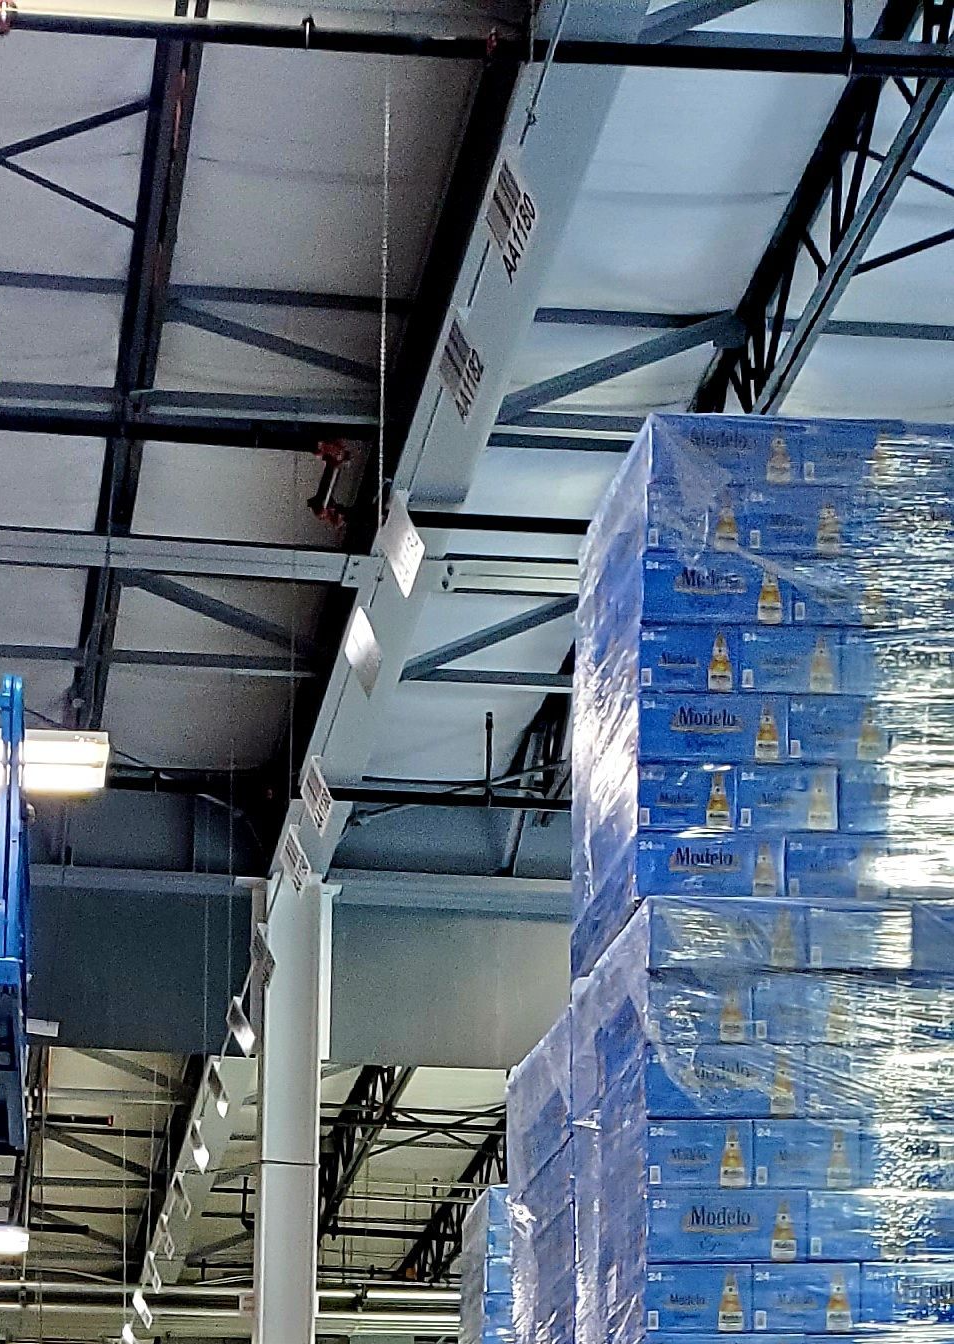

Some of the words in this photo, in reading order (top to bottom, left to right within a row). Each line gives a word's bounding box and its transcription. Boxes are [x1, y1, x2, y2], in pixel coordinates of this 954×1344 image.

[502, 192, 537, 284] AA1180
[454, 348, 485, 425] AA1182
[649, 1127, 664, 1137] 24
[756, 1127, 771, 1137] 24
[652, 1200, 667, 1209] 24
[691, 1205, 751, 1226] Modelo
[647, 1272, 663, 1282] 24
[754, 1272, 770, 1282] 24
